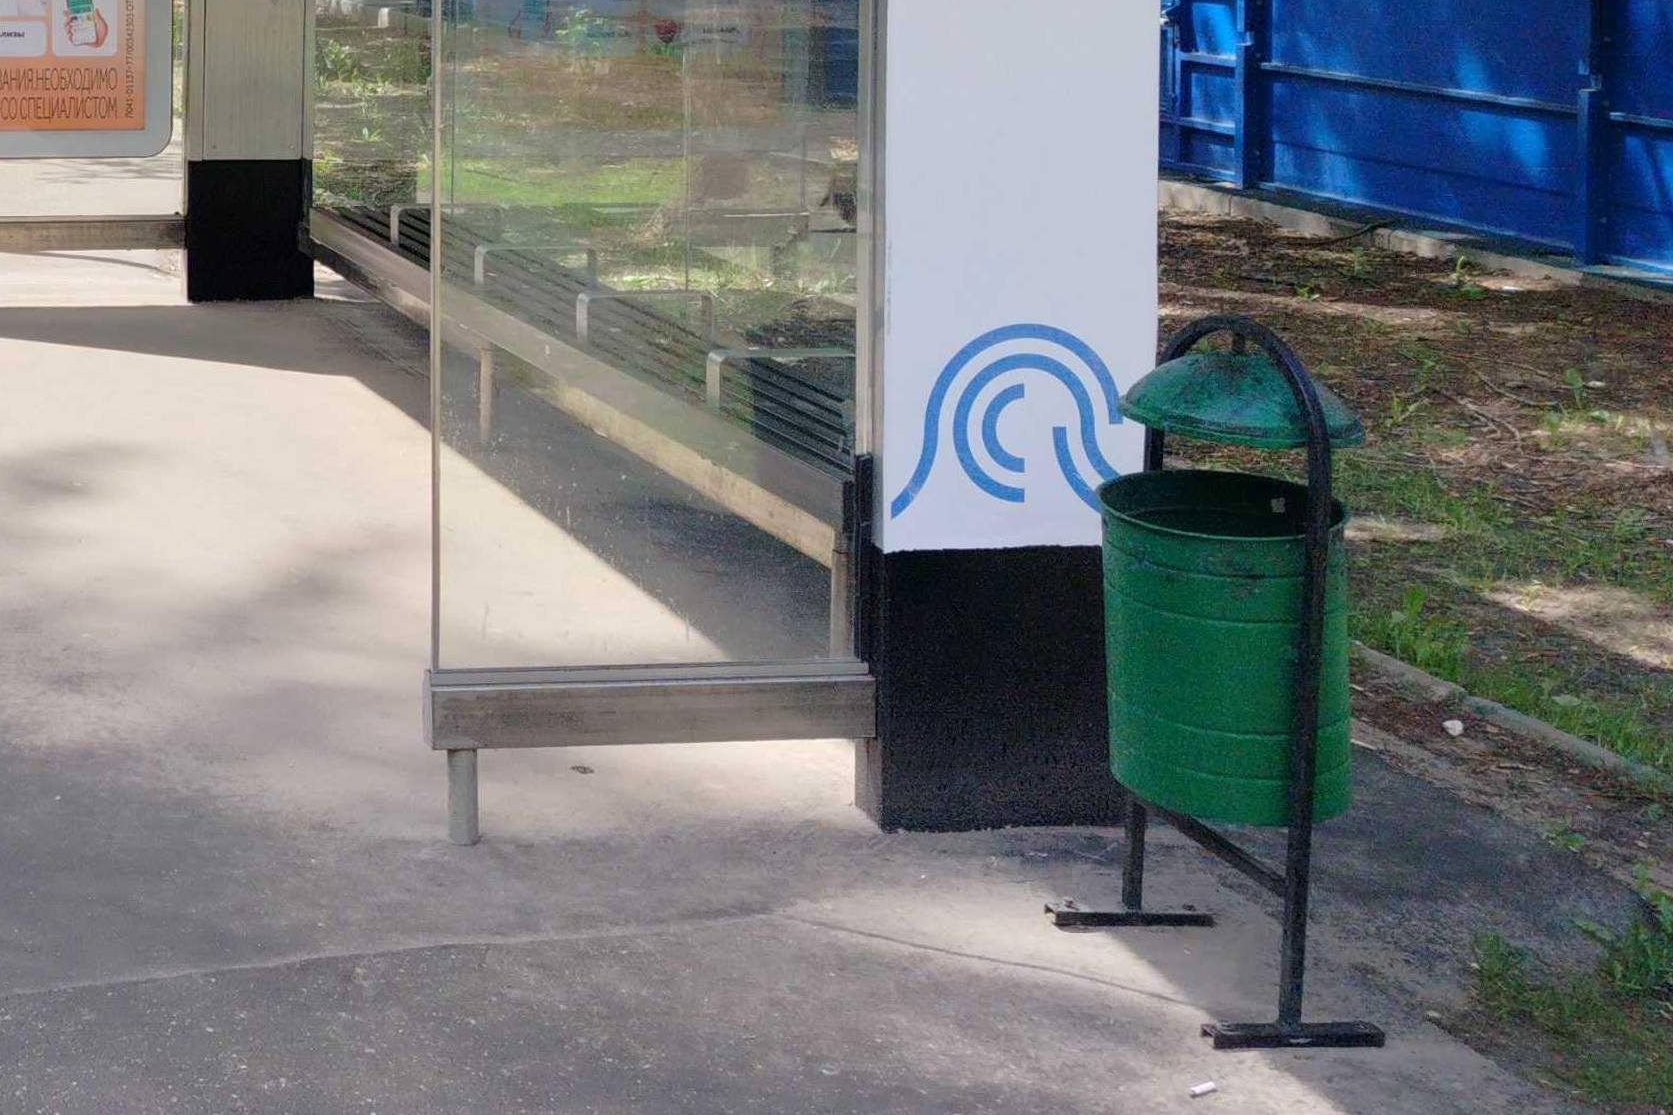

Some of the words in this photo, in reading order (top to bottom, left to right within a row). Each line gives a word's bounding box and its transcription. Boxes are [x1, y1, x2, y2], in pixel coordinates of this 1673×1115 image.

[35, 66, 119, 95] НЕОБХОДИМО
[0, 96, 18, 121] СО
[19, 95, 119, 124] СПЕЦИАЛИСТОМ
